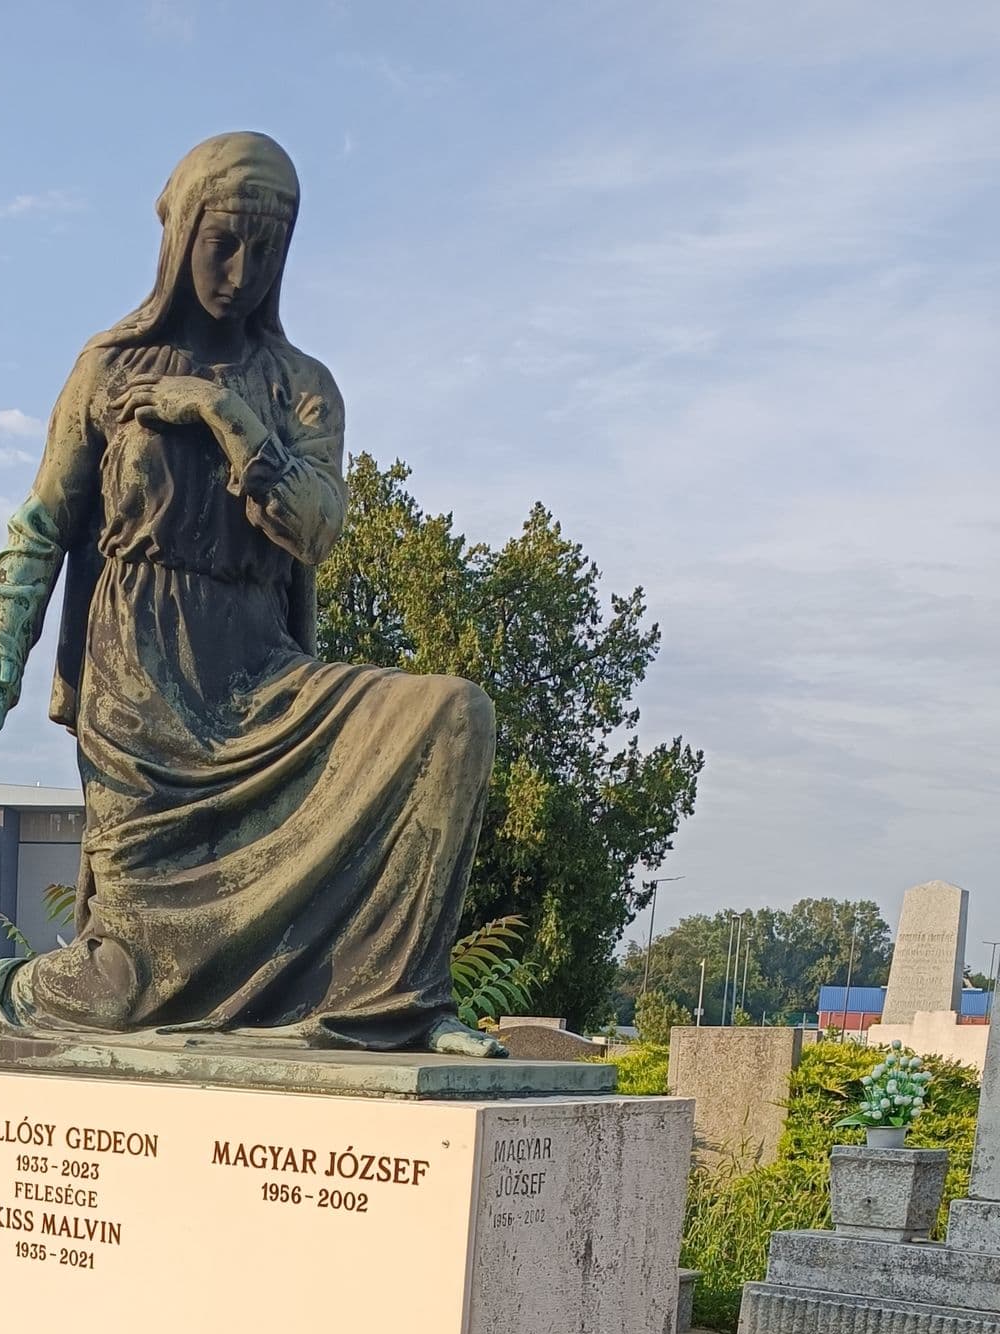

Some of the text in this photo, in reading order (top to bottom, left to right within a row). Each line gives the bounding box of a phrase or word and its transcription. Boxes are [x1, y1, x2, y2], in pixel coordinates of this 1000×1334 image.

[65, 1126, 159, 1158] GEDEON
[494, 1137, 551, 1162] MAGYAR
[210, 1140, 431, 1187] MAGYAR JÓZSEF
[14, 1180, 98, 1209] FELESÉGE
[40, 1212, 122, 1246] MALVIN
